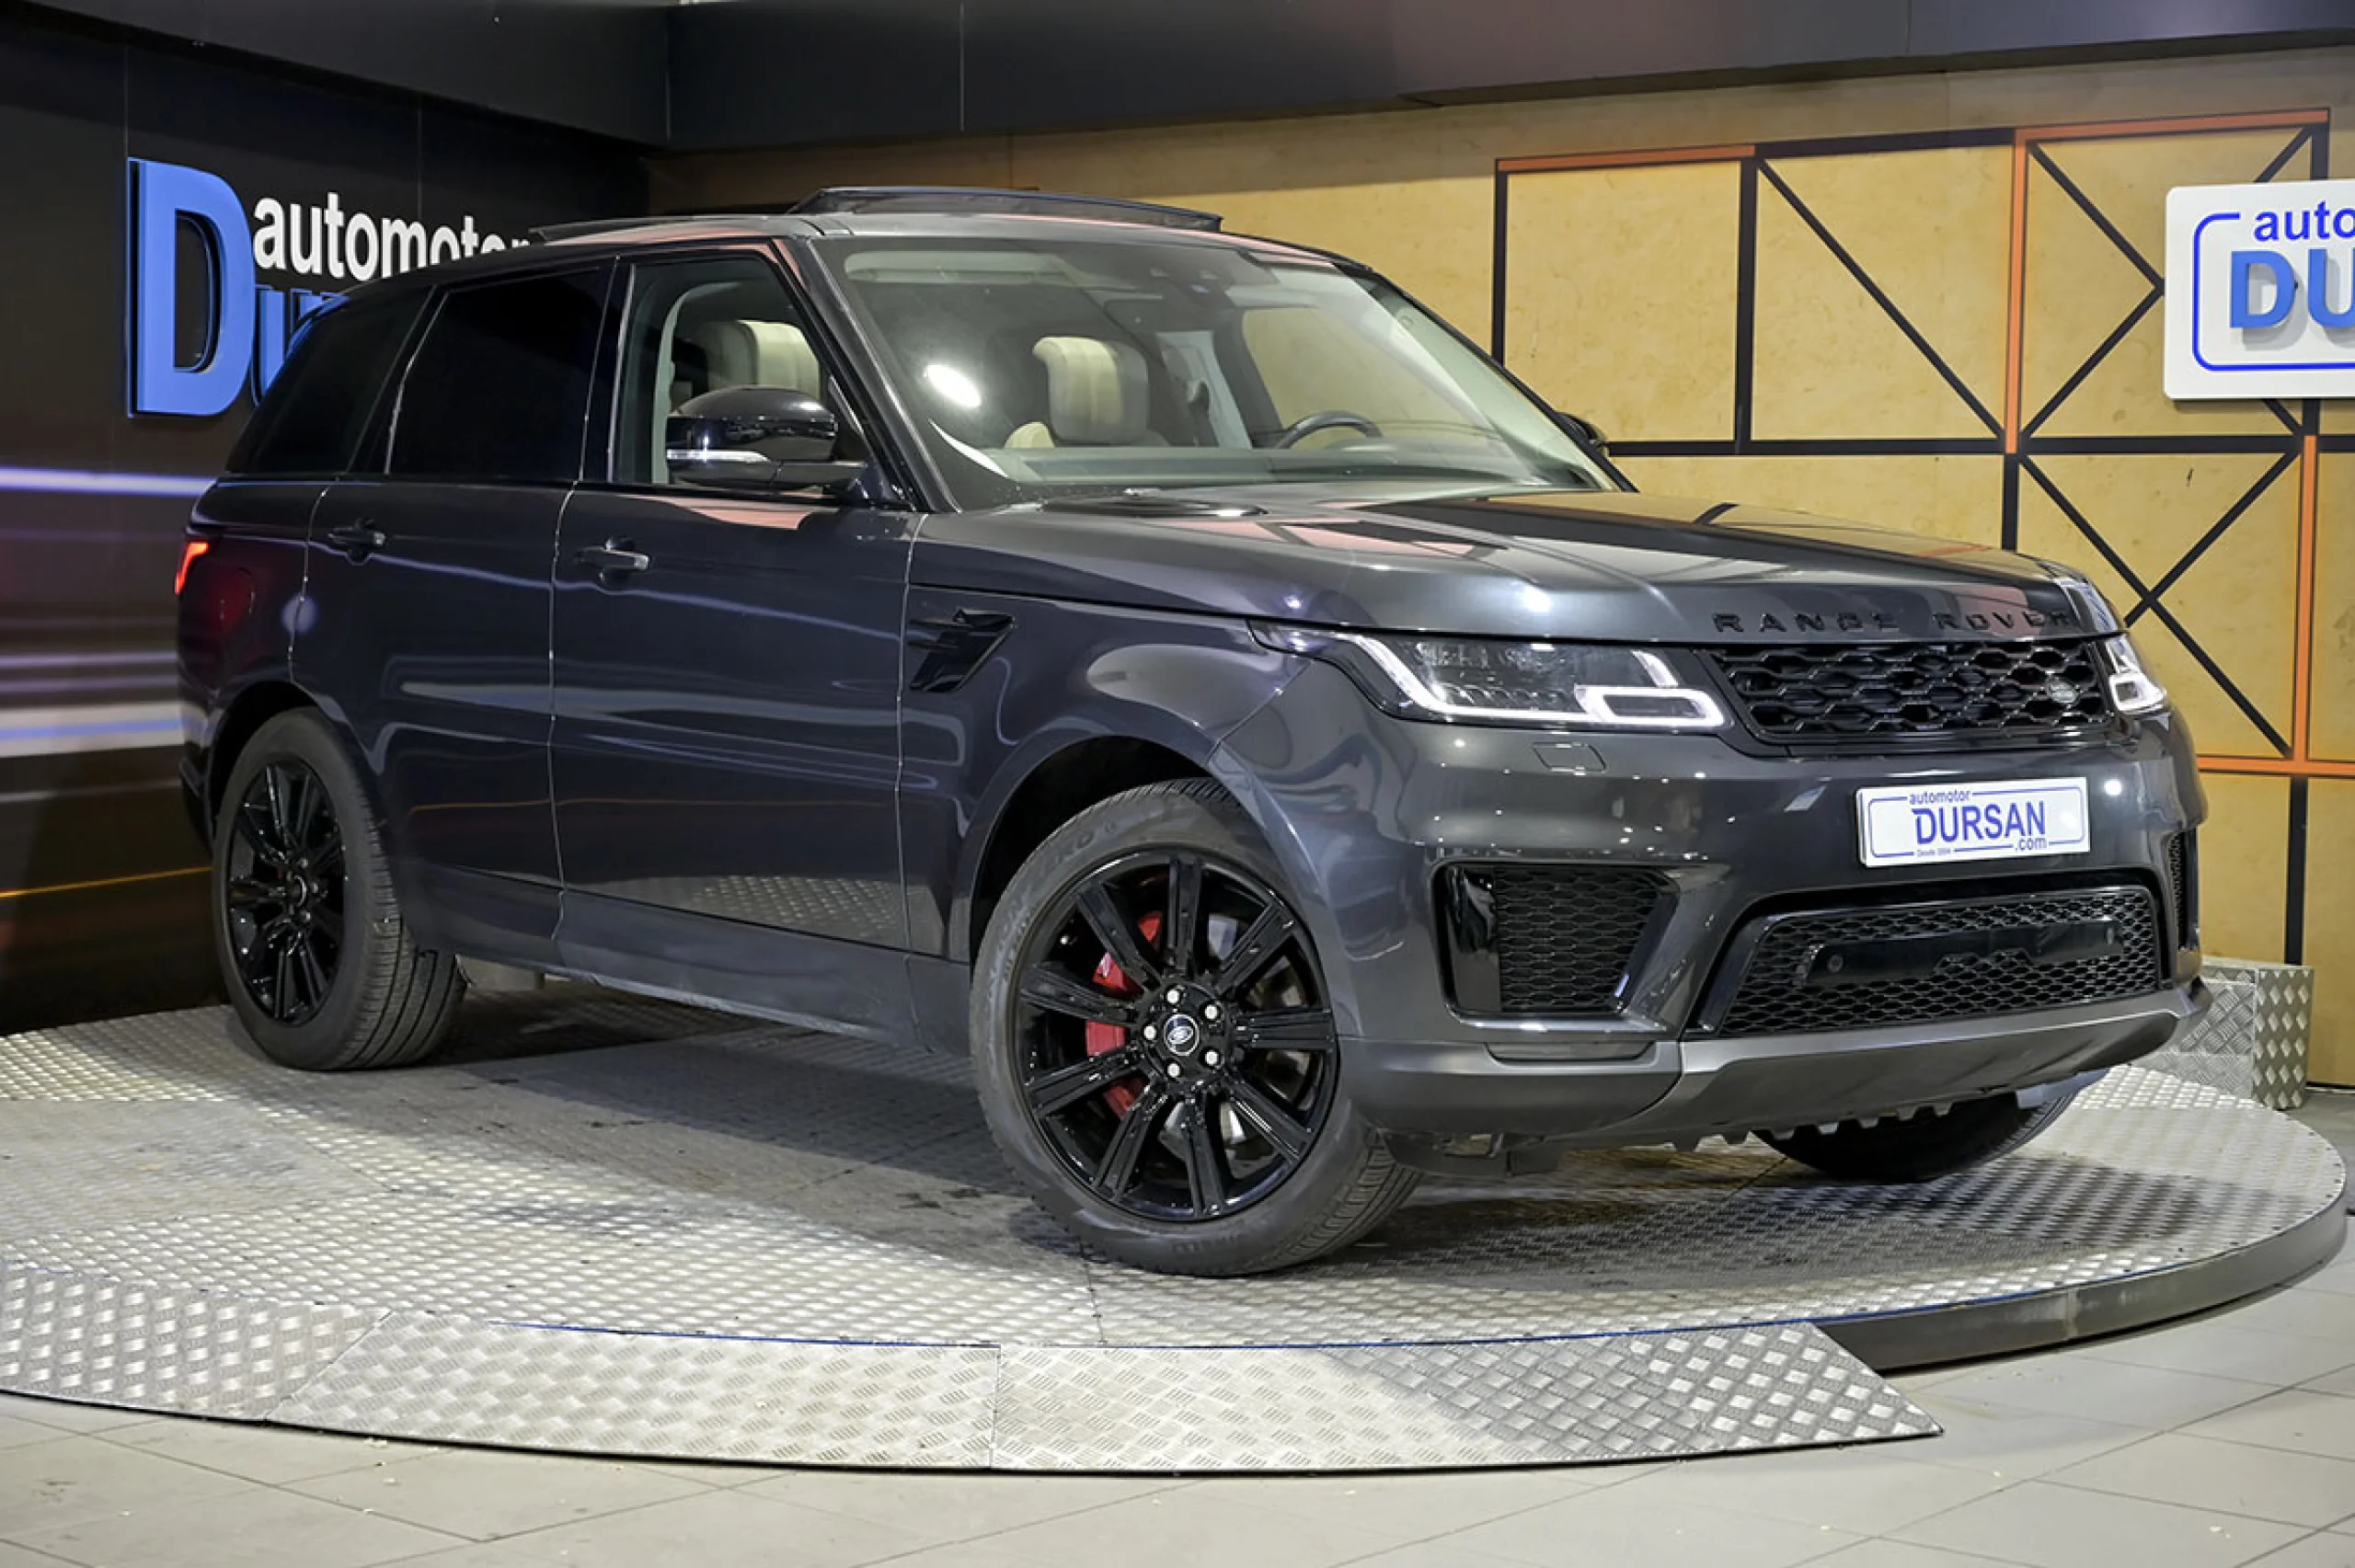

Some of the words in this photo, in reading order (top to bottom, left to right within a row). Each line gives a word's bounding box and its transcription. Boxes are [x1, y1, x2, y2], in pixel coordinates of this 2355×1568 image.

[1712, 612, 1901, 633] RANGE
[1933, 610, 2072, 630] ROVER
[1909, 789, 1971, 806] automotor
[1911, 800, 2046, 845] DURSAN
